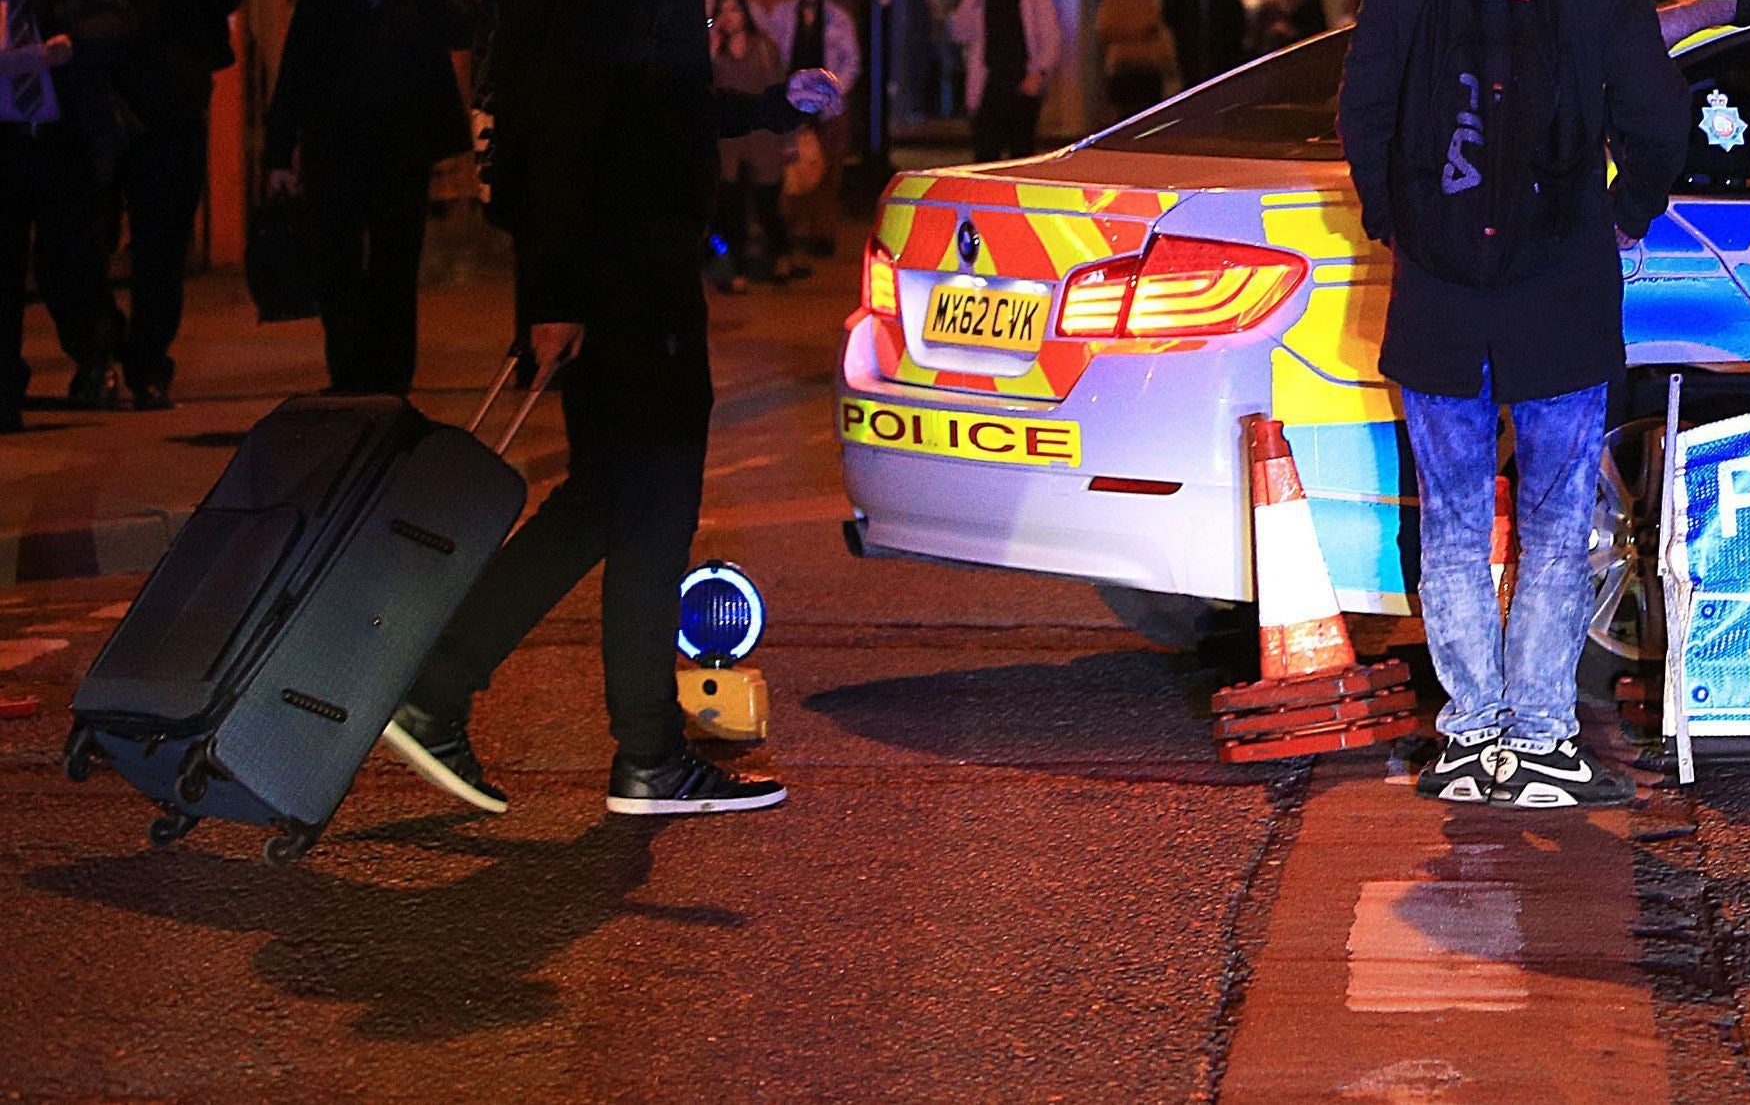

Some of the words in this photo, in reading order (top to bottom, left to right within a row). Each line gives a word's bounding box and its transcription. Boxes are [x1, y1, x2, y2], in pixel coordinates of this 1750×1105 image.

[932, 291, 991, 336] MX62
[992, 296, 1037, 341] CVK
[842, 403, 1075, 459] POLICE
